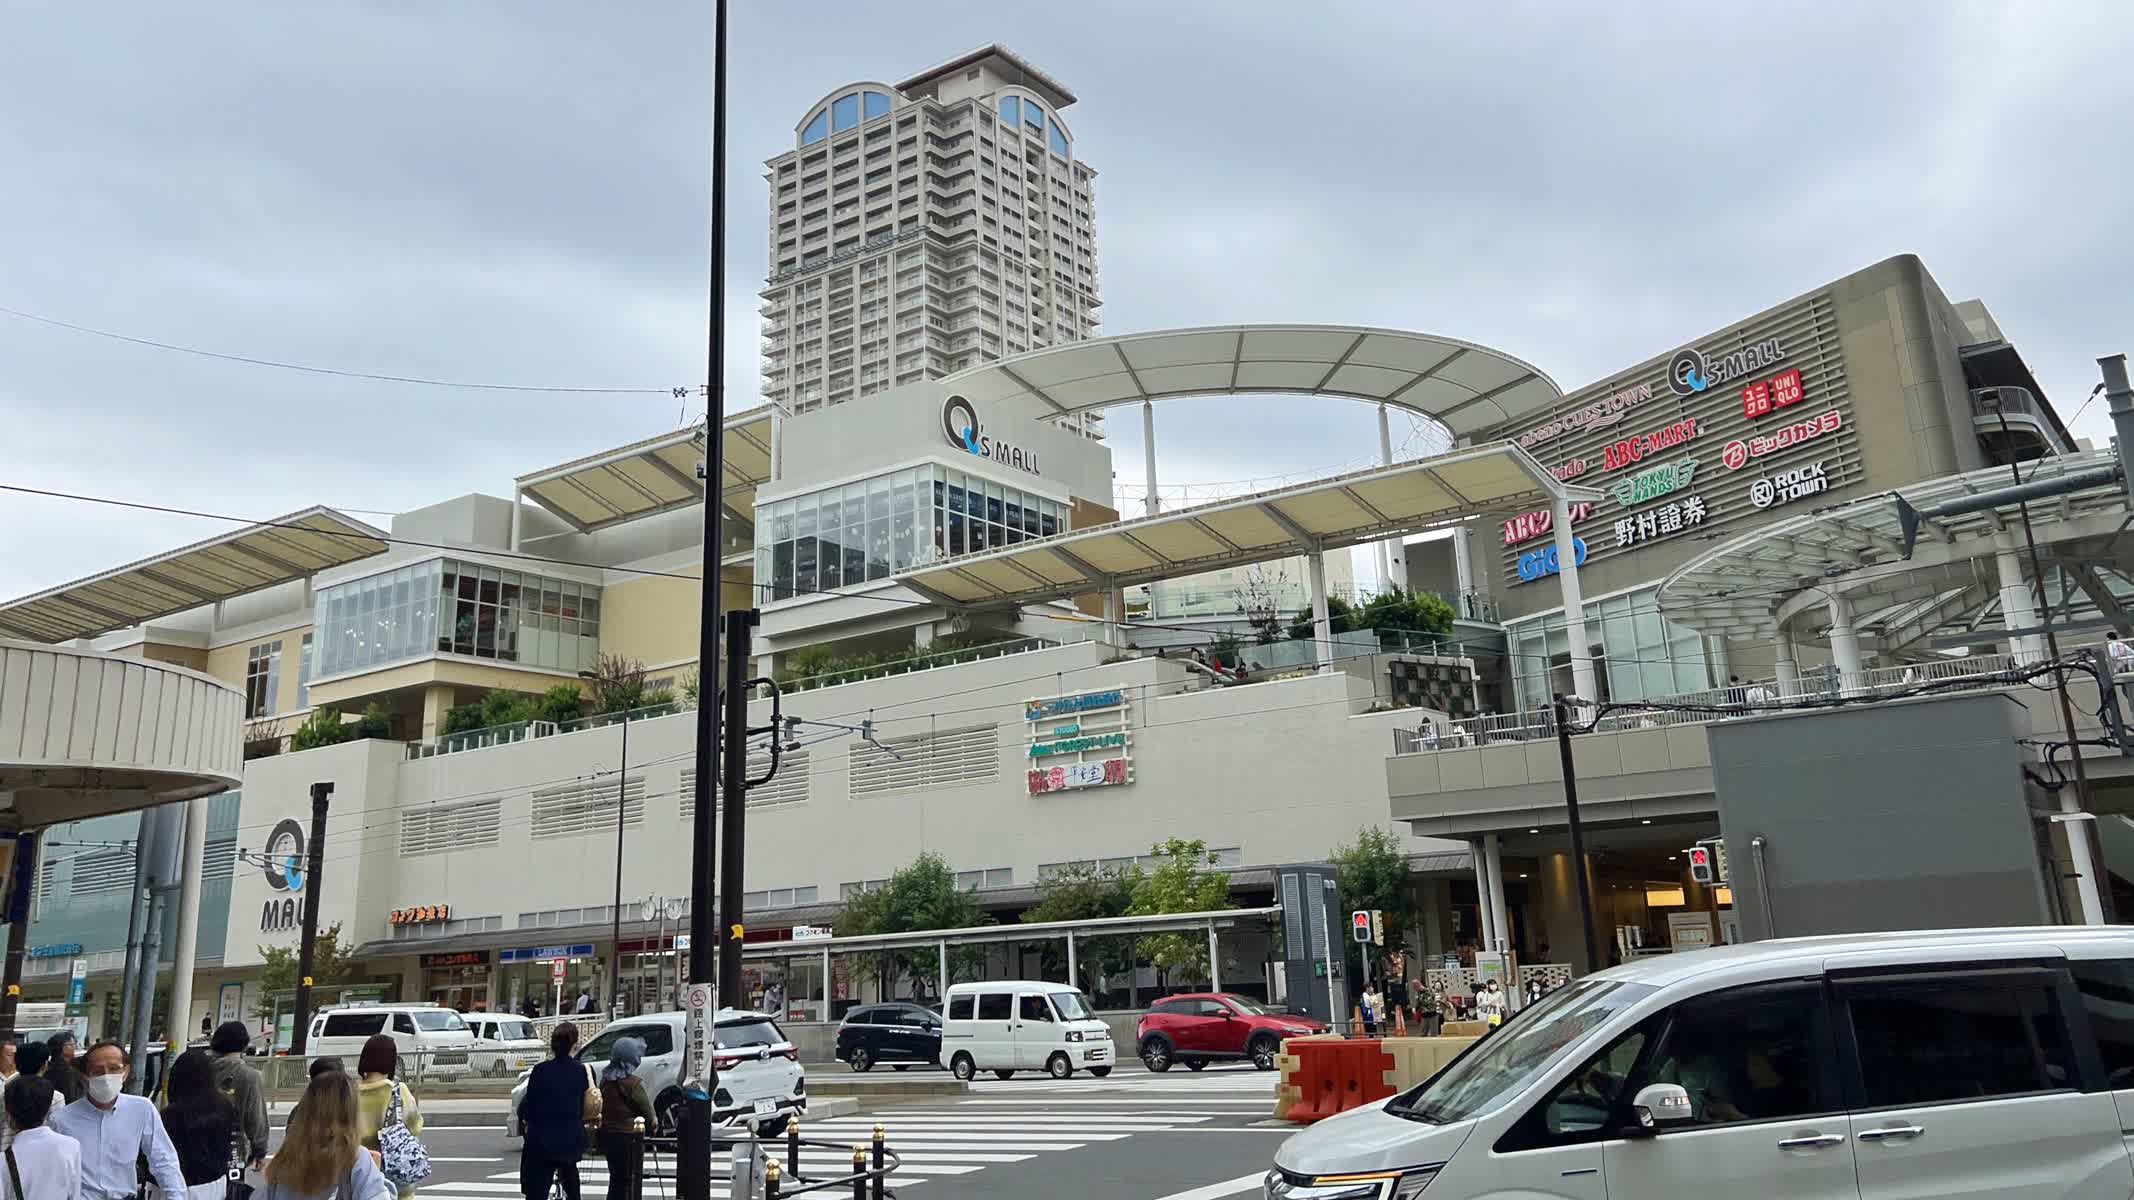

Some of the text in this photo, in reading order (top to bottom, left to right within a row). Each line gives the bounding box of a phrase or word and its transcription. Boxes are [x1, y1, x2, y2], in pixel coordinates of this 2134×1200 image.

[1722, 337, 1786, 380] MALL
[1745, 385, 1765, 401] ユニ
[1775, 374, 1796, 391] UNI
[1776, 389, 1800, 405] QLO
[1602, 383, 1653, 414] TOWN
[1602, 417, 1697, 472] ABC-MART
[1749, 410, 1841, 457] ビックカメラ
[995, 440, 1041, 475] MALL
[1633, 464, 1674, 490] TOKYU
[1775, 463, 1825, 488] ROCK
[1777, 478, 1828, 500] TOWN
[1614, 496, 1706, 547] 野村證券
[260, 897, 308, 930] MAL
